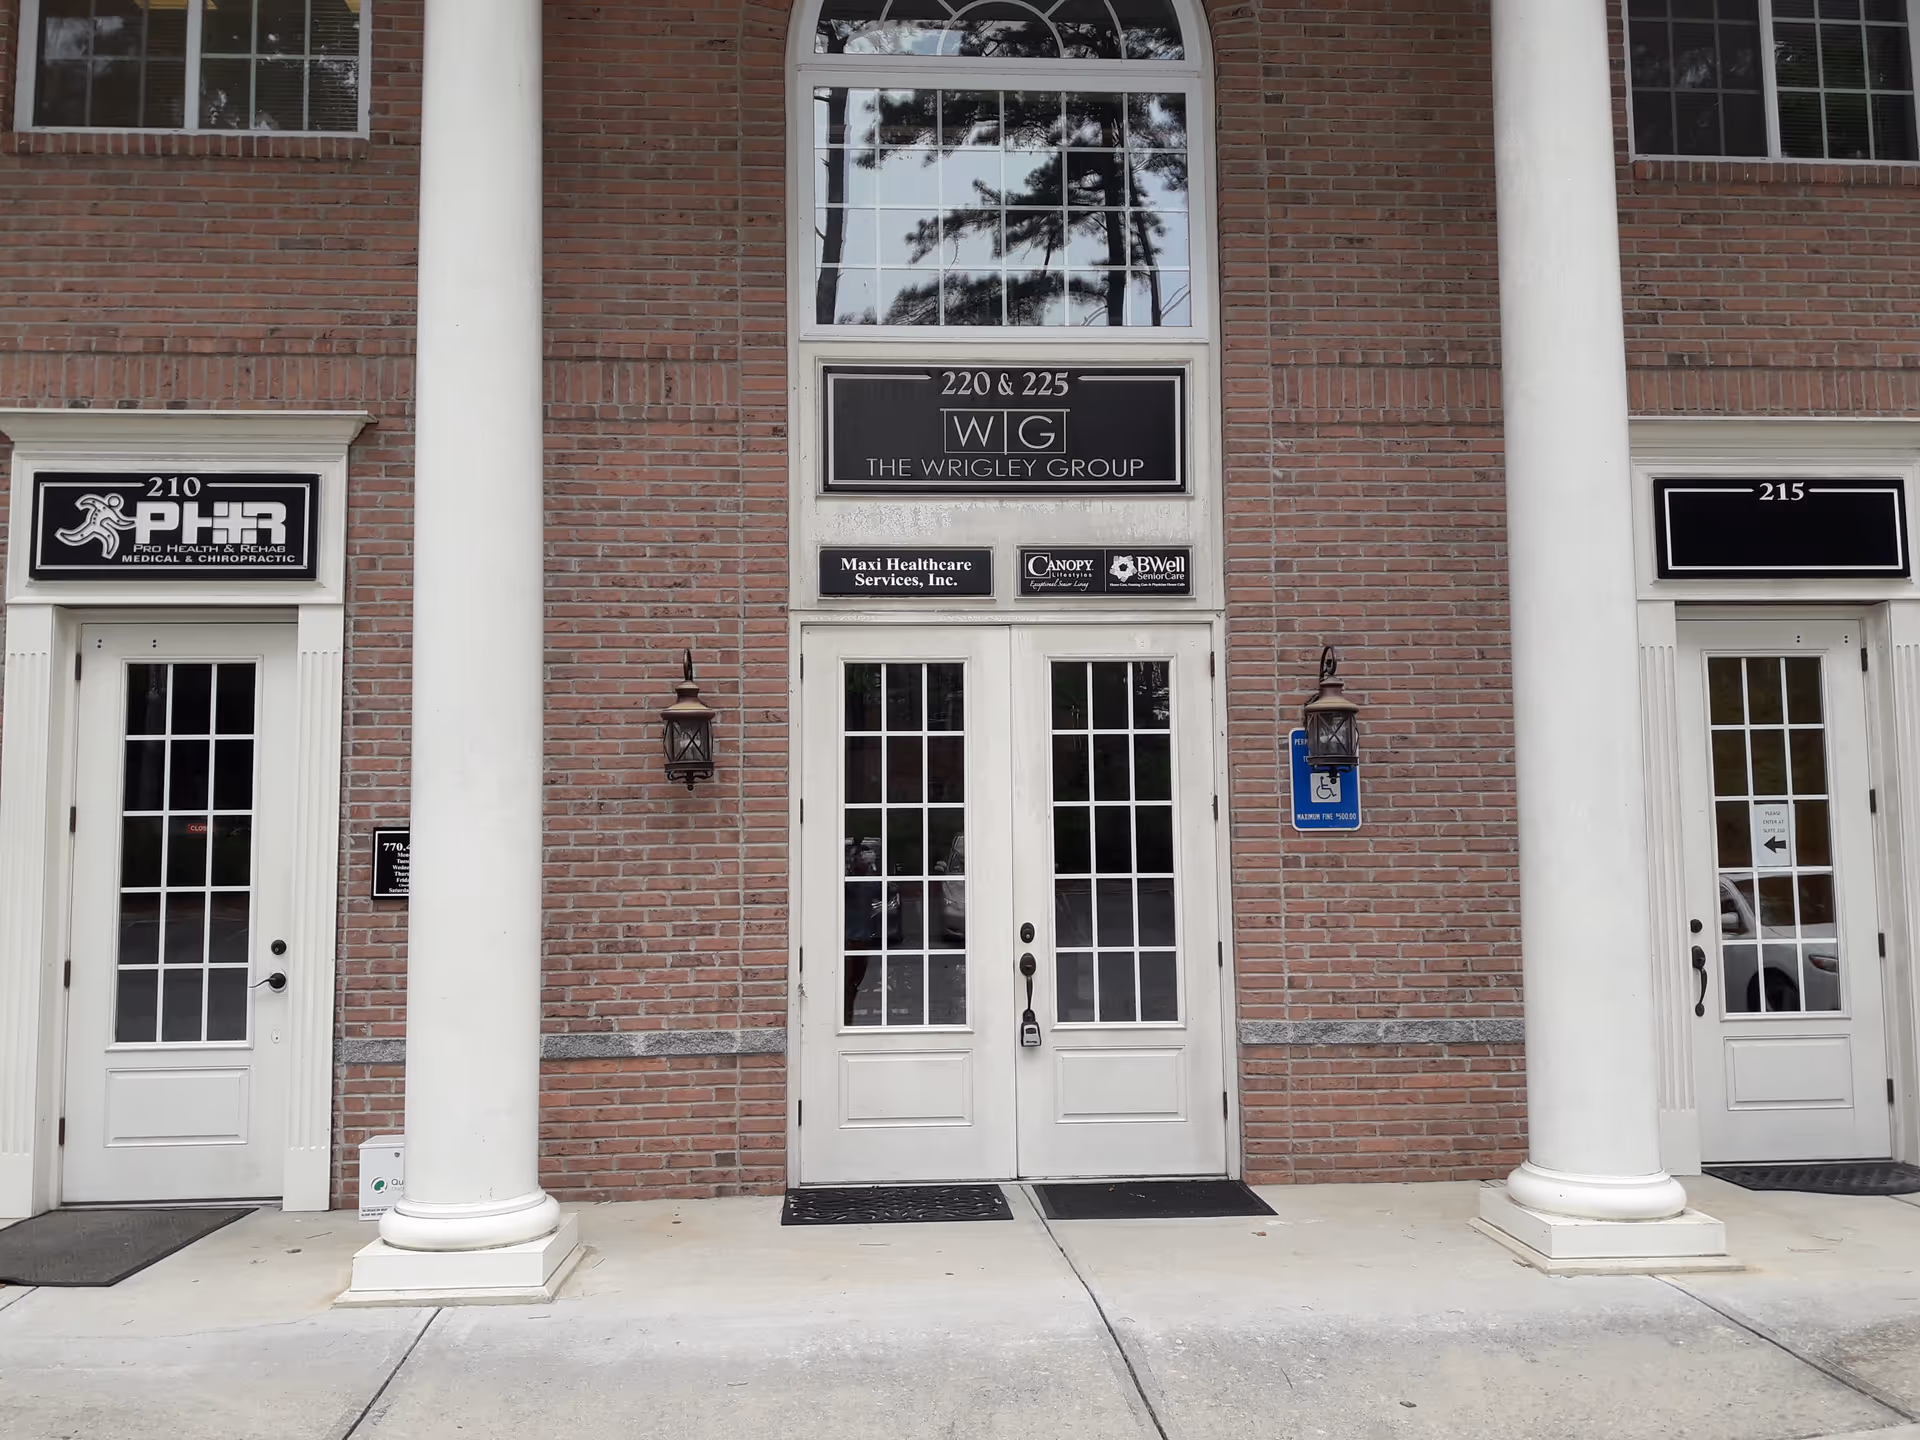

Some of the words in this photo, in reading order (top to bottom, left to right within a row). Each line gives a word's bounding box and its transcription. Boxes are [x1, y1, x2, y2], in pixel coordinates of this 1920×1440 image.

[941, 371, 991, 396] 220
[998, 372, 1014, 396] &
[1022, 371, 1069, 396] 225
[866, 458, 912, 477] THE
[921, 458, 1037, 477] WRIGLEY
[1046, 458, 1145, 478] GROUP
[146, 476, 201, 497] 210
[1759, 482, 1805, 501] 215
[223, 545, 234, 553] &
[122, 554, 180, 563] MEDICAL
[185, 555, 193, 563] &
[198, 554, 296, 563] CHIROPRACTIC
[840, 558, 881, 571] Maxi
[886, 558, 972, 571] Healthcare
[1136, 556, 1185, 573] BWell
[855, 573, 924, 588] Services,
[928, 573, 958, 586] Inc.
[1137, 572, 1185, 580] SeniorCare
[1322, 812, 1333, 820] FINE
